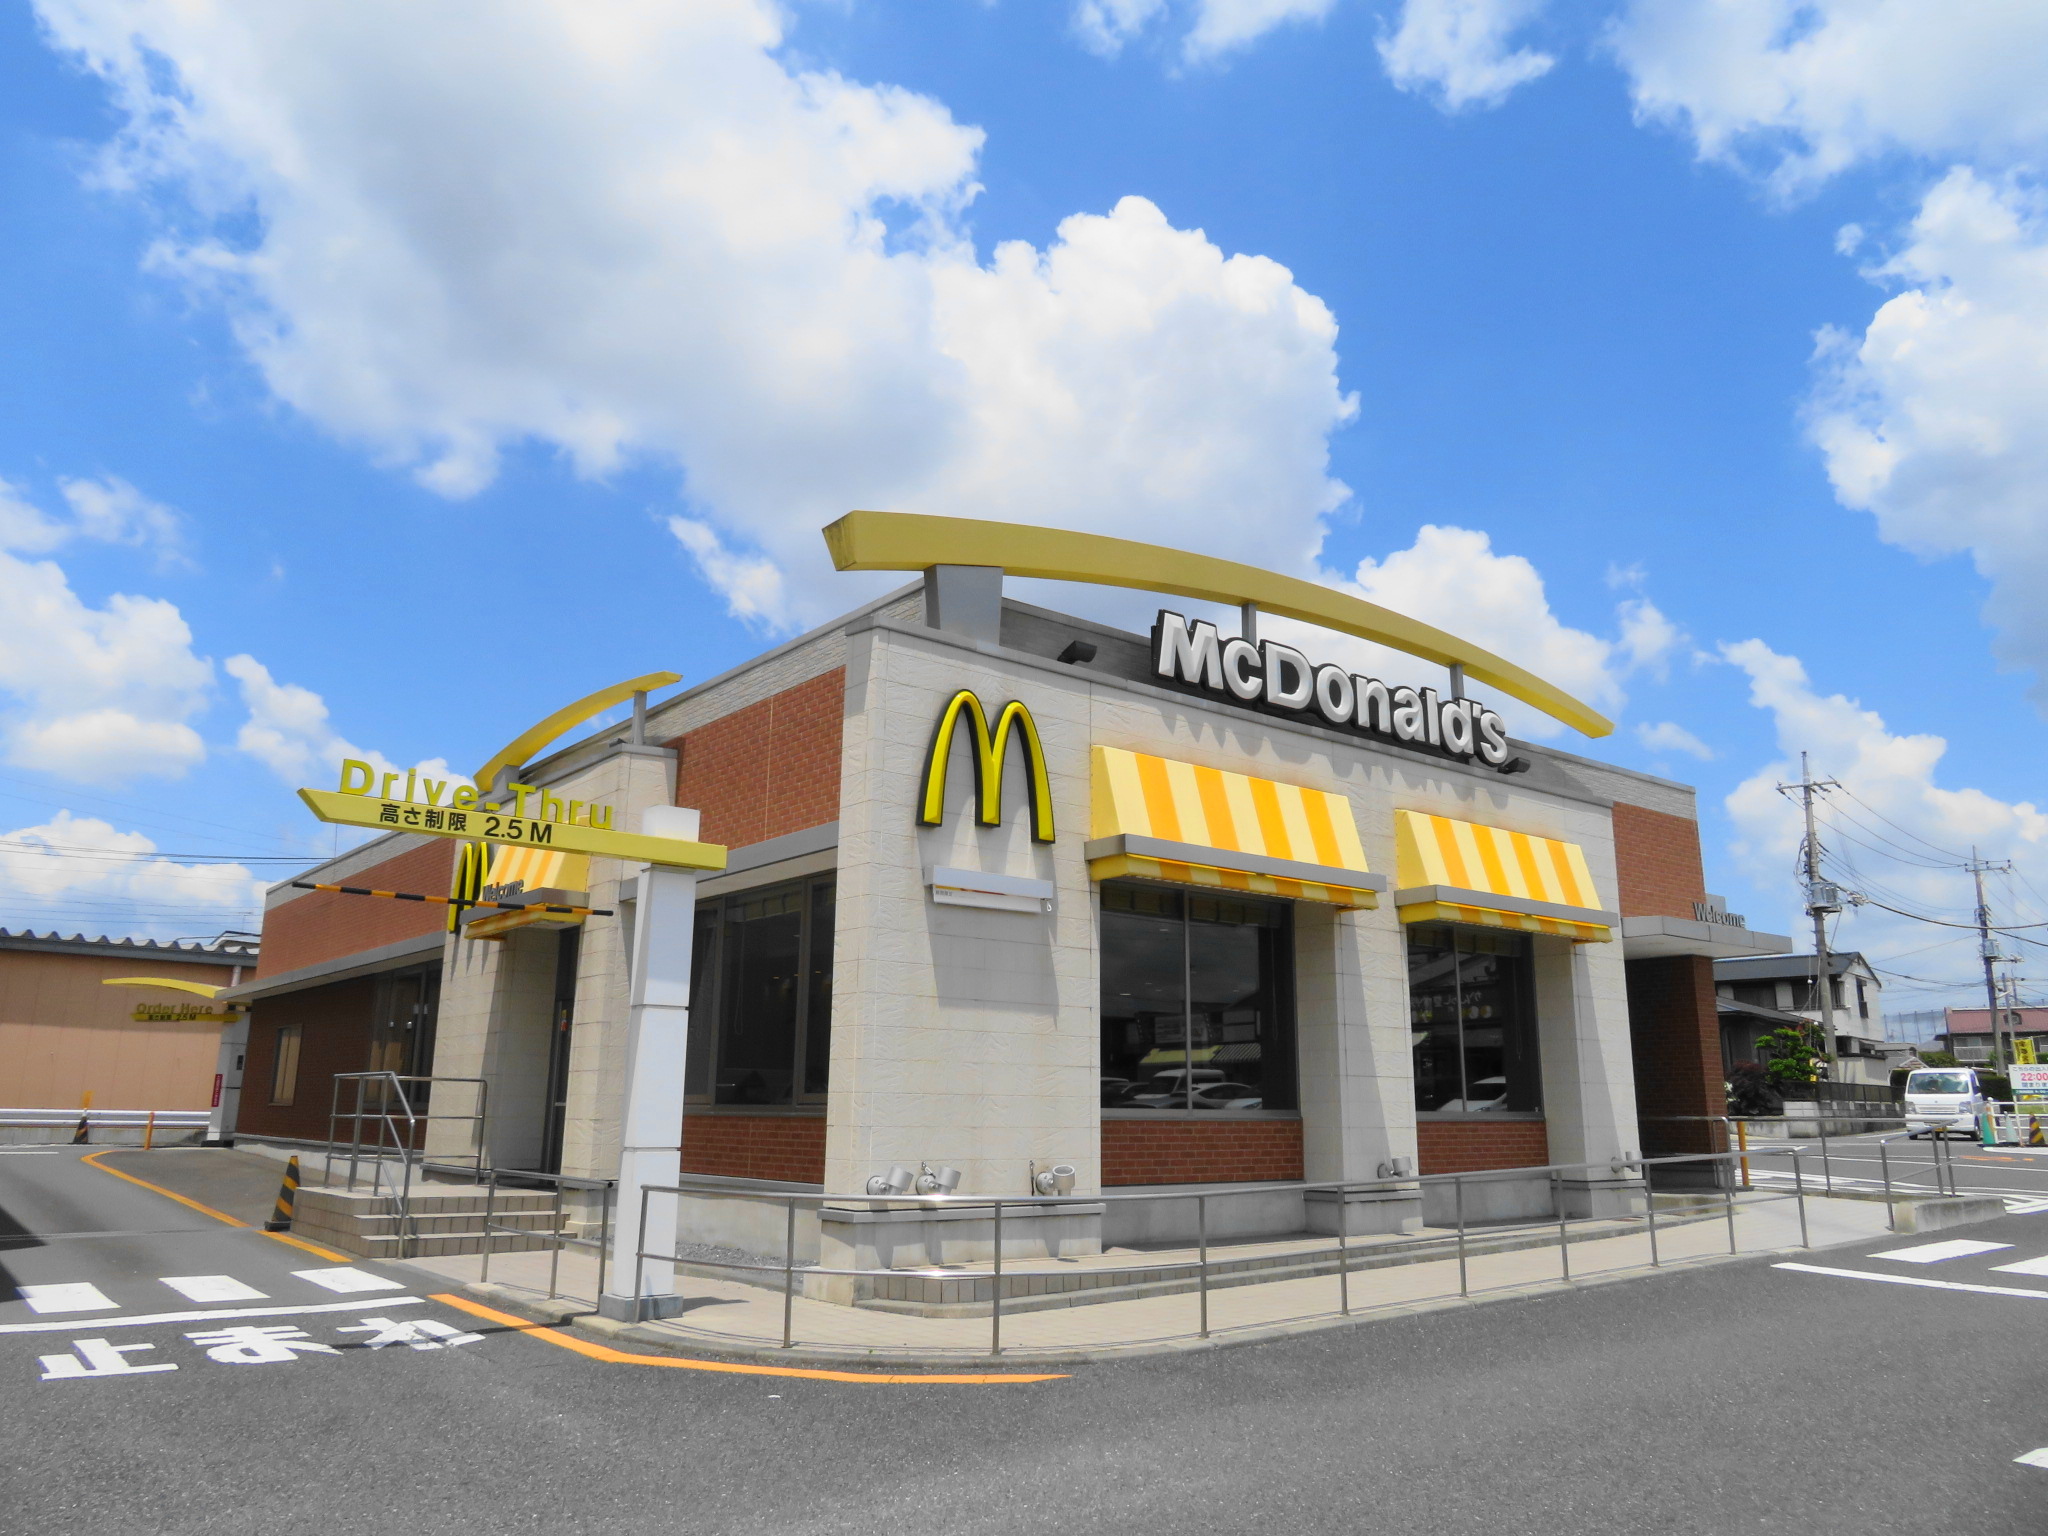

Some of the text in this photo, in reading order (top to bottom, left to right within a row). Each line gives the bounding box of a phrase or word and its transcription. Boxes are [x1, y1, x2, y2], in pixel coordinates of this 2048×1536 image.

[1152, 609, 1508, 766] McDonald's
[340, 758, 615, 831] Drive-Thru
[380, 803, 467, 832] 高さ制限
[482, 879, 524, 902] Welcome
[1693, 902, 1745, 928] Welcome
[137, 1003, 213, 1014] Order Here
[2020, 1072, 2048, 1081] 22:00
[37, 1318, 486, 1380] 止まれ
